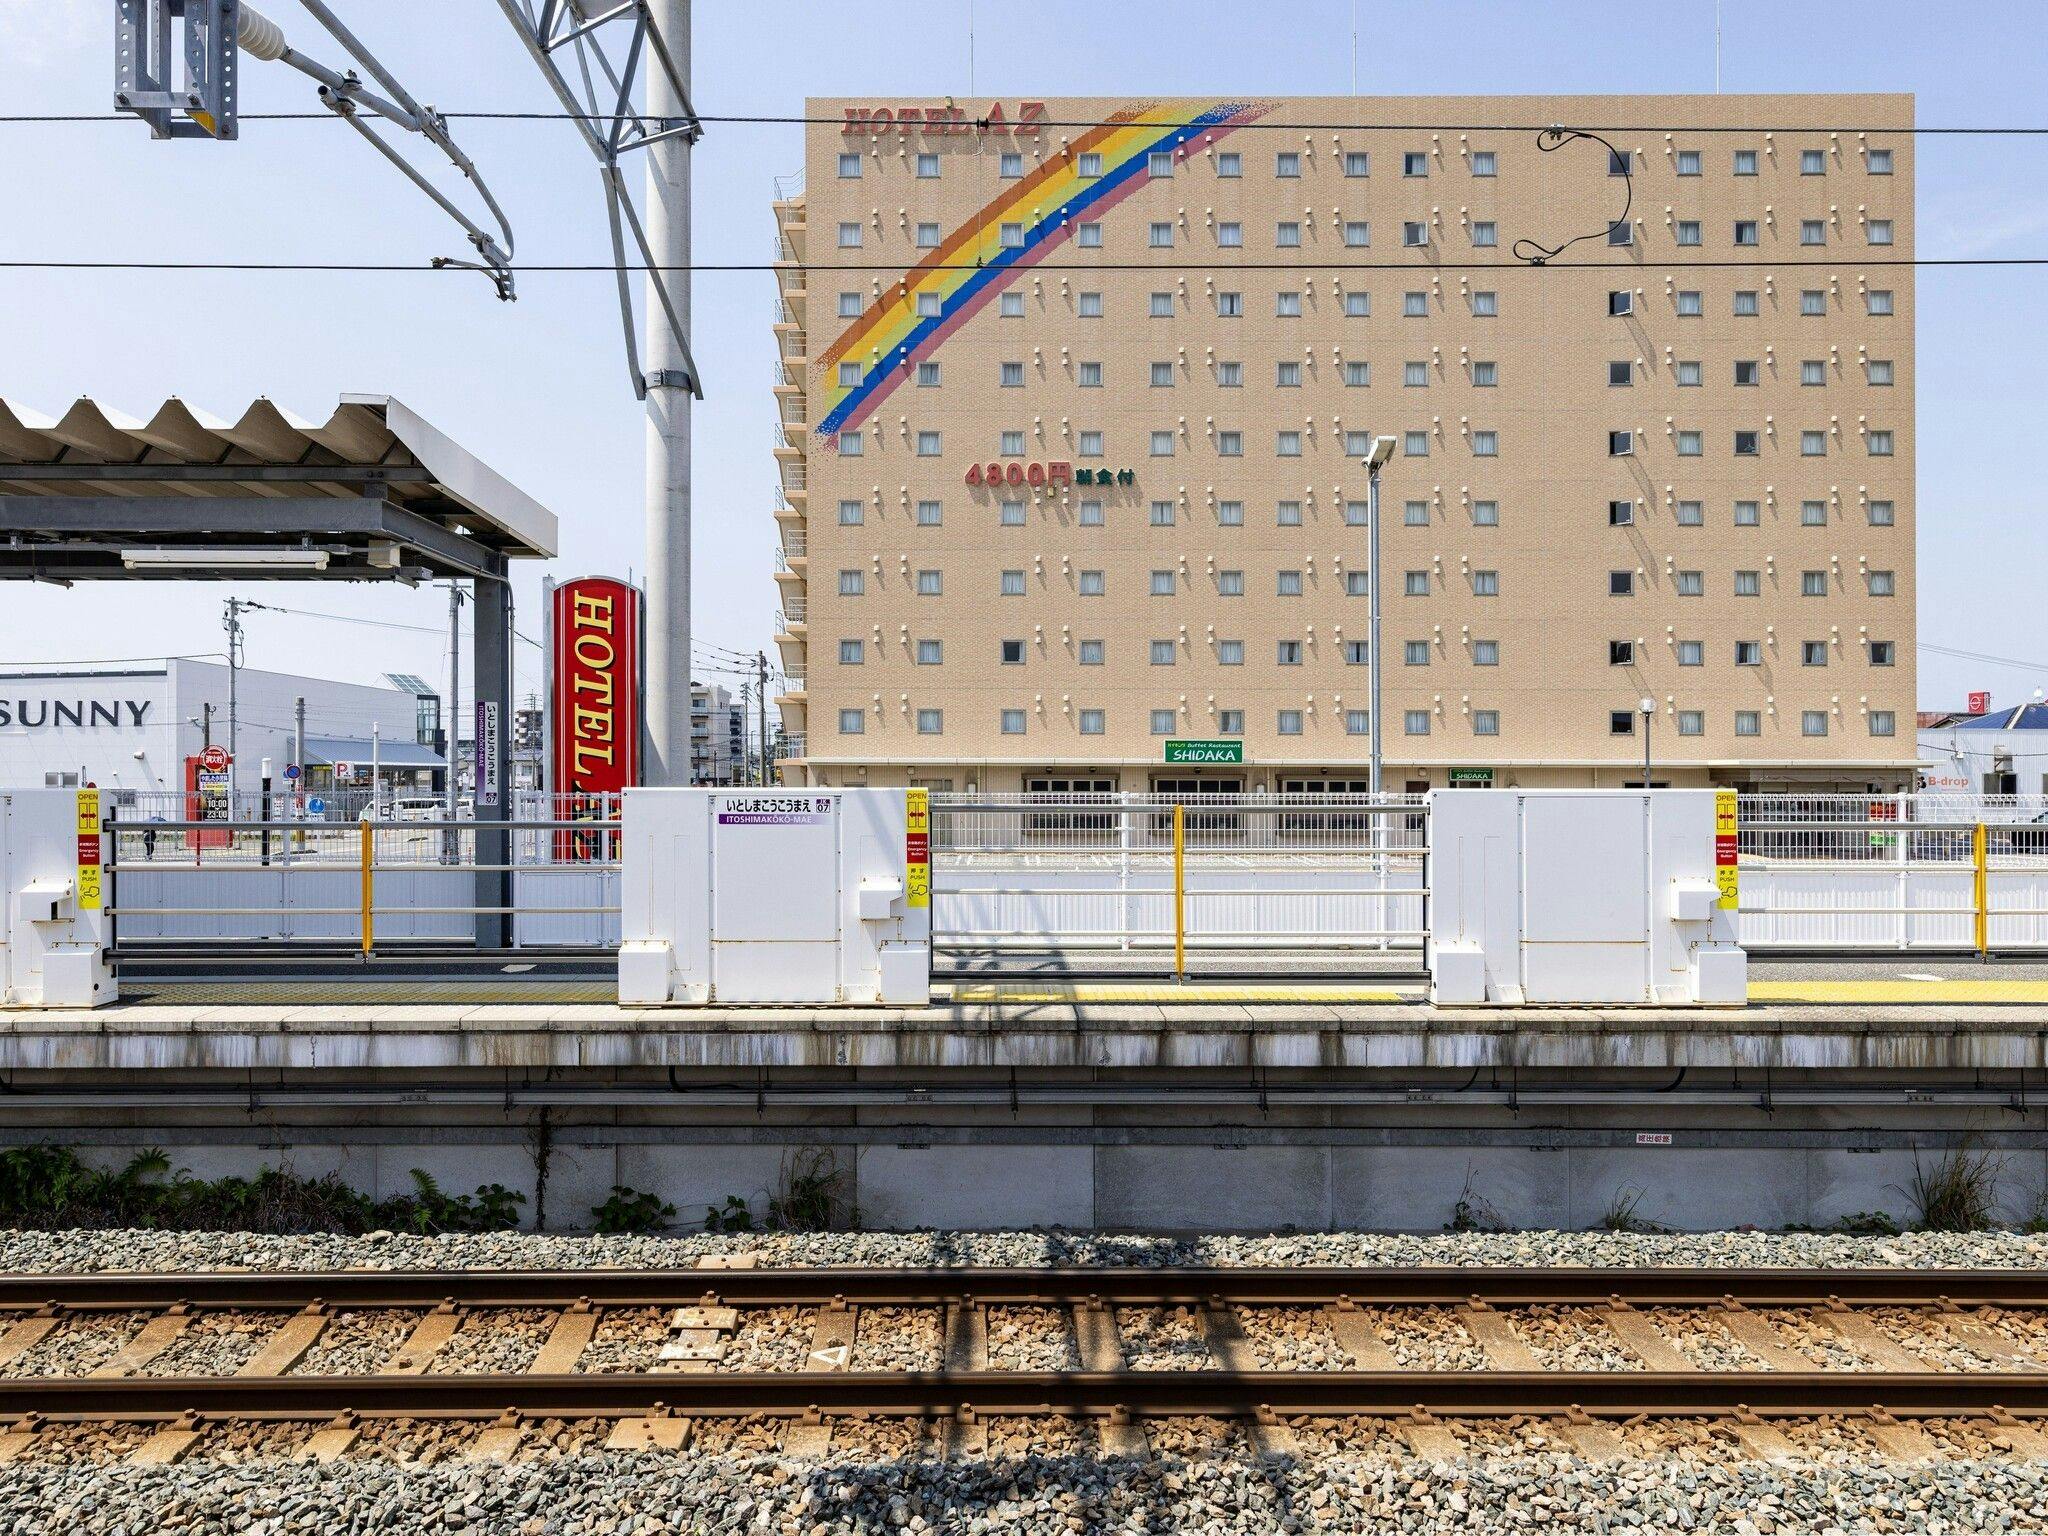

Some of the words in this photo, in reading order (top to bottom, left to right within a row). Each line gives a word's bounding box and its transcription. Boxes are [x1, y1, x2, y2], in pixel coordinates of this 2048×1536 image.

[841, 107, 973, 136] HOTEL
[977, 101, 1045, 136] AZ
[964, 461, 1071, 487] 4800円
[574, 589, 616, 775] HOTEL
[0, 699, 151, 728] SUNNY
[486, 705, 497, 786] いとしまこうこうまえ
[1172, 749, 1236, 761] SHIDAKA
[337, 763, 347, 776] P
[1928, 776, 1969, 787] B-drop
[78, 793, 99, 801] OPEN
[208, 799, 228, 808] 10:00
[486, 796, 496, 804] 07
[726, 799, 811, 812] いとしまこうこうまえ
[817, 804, 829, 812] 07
